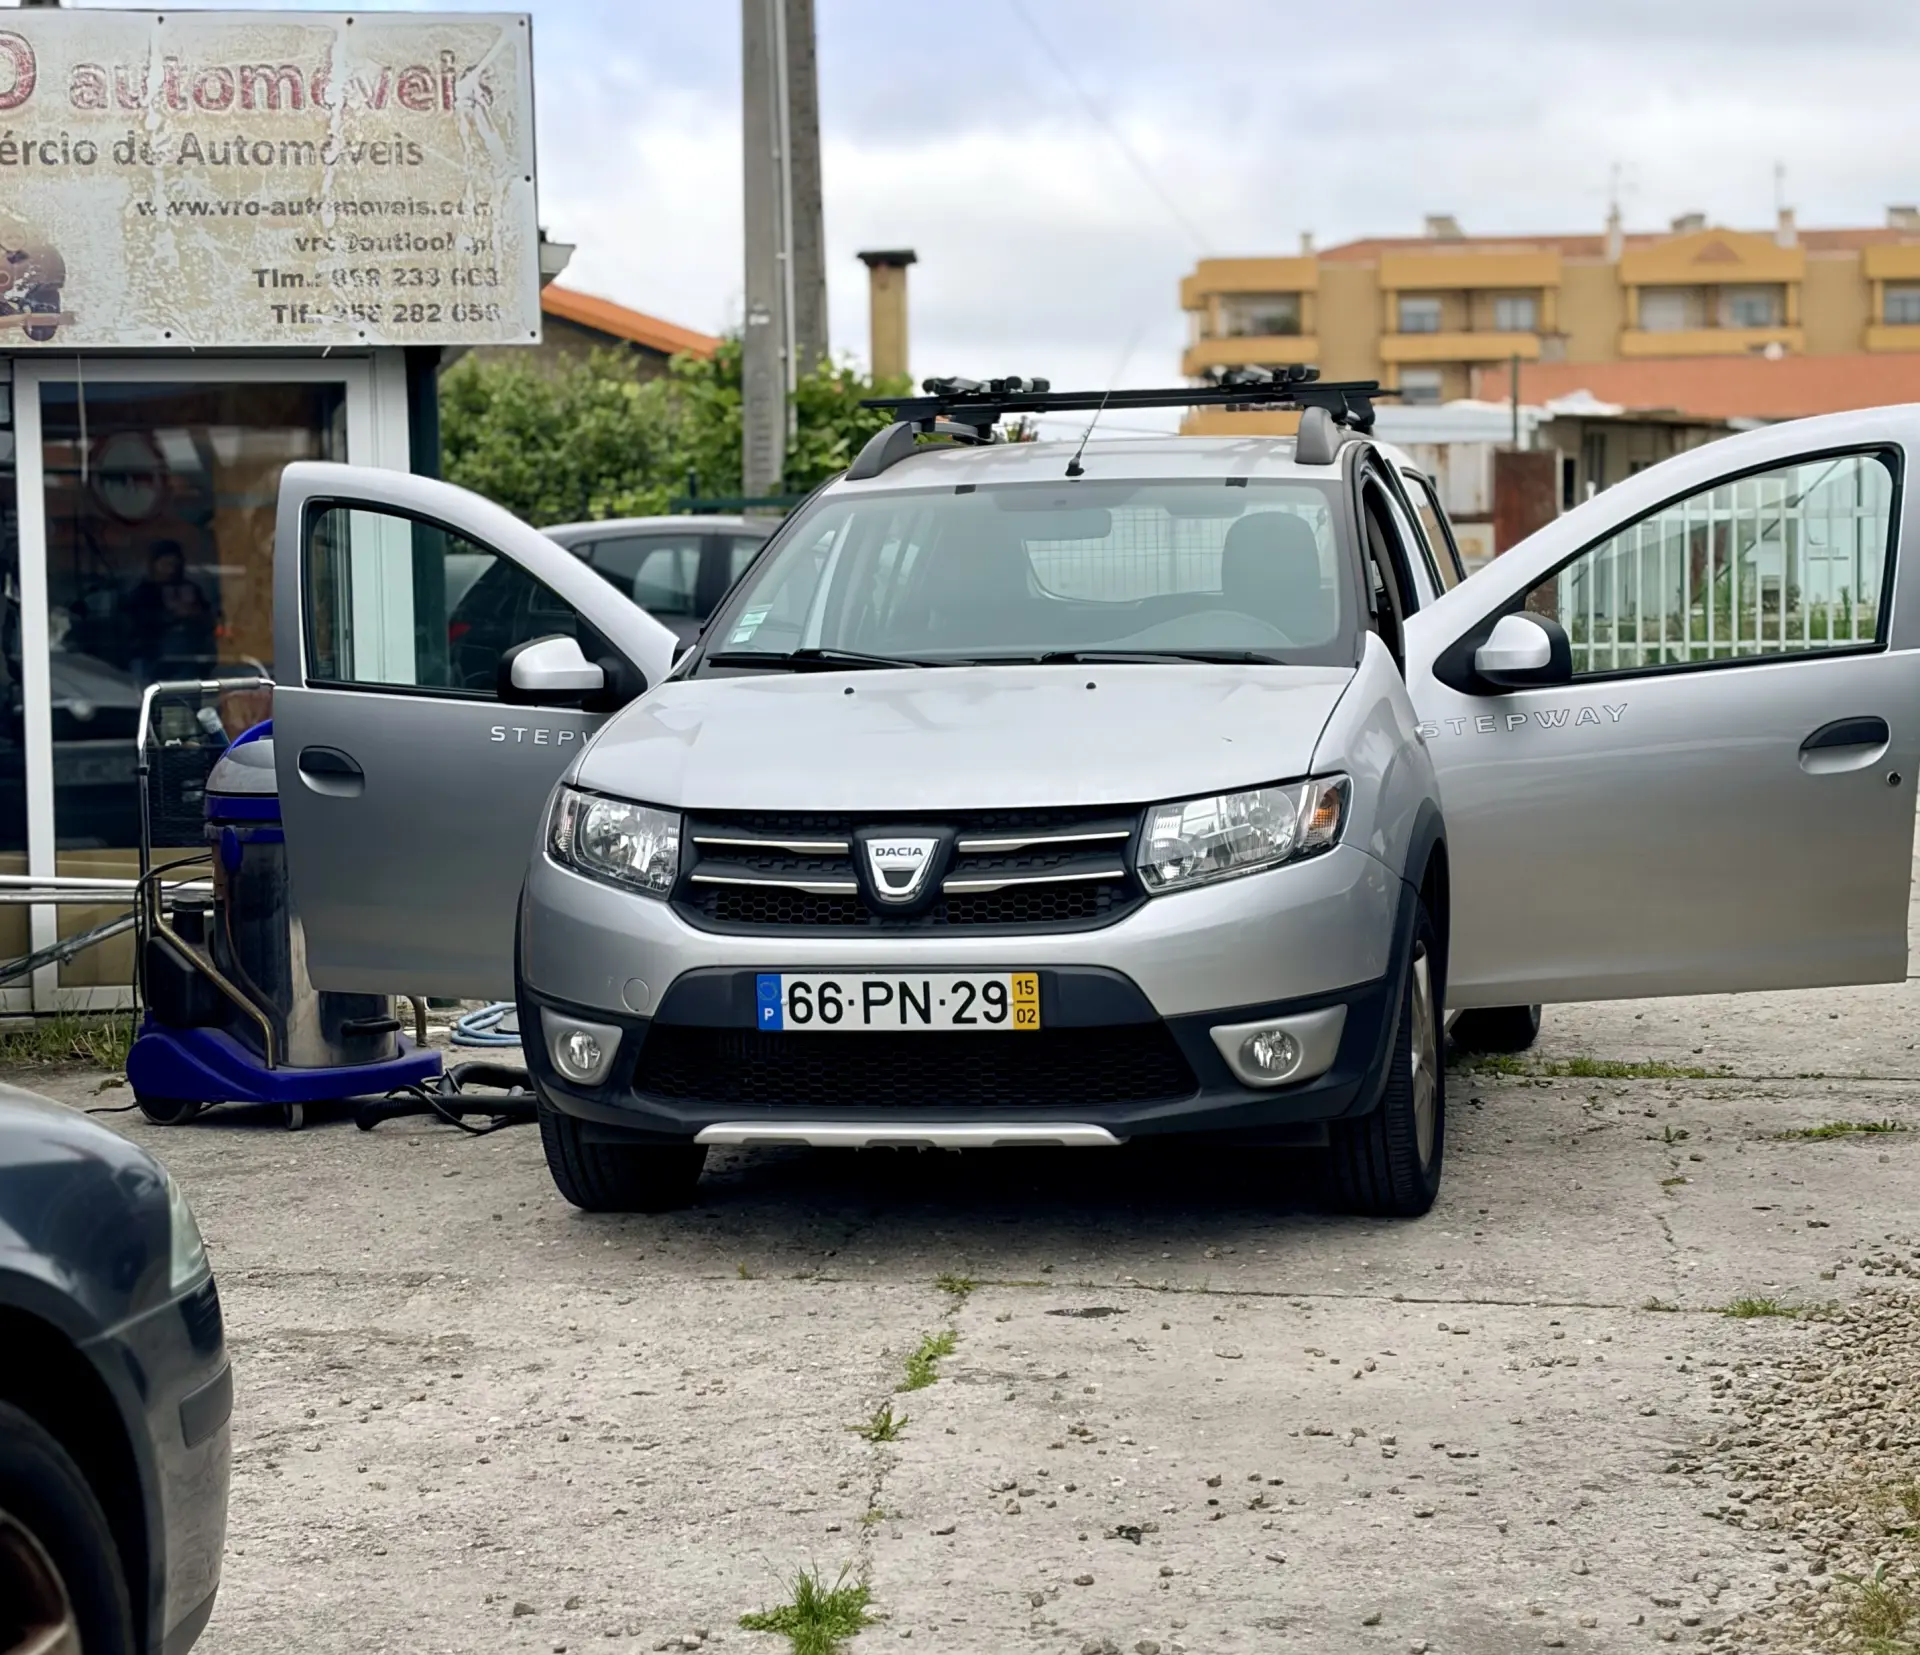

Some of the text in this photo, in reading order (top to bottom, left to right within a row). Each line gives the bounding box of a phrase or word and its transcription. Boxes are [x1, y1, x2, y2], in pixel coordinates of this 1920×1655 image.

[393, 303, 441, 323] 282
[875, 846, 923, 857] DACIA
[1016, 980, 1034, 996] 15
[1016, 1008, 1036, 1024] 02
